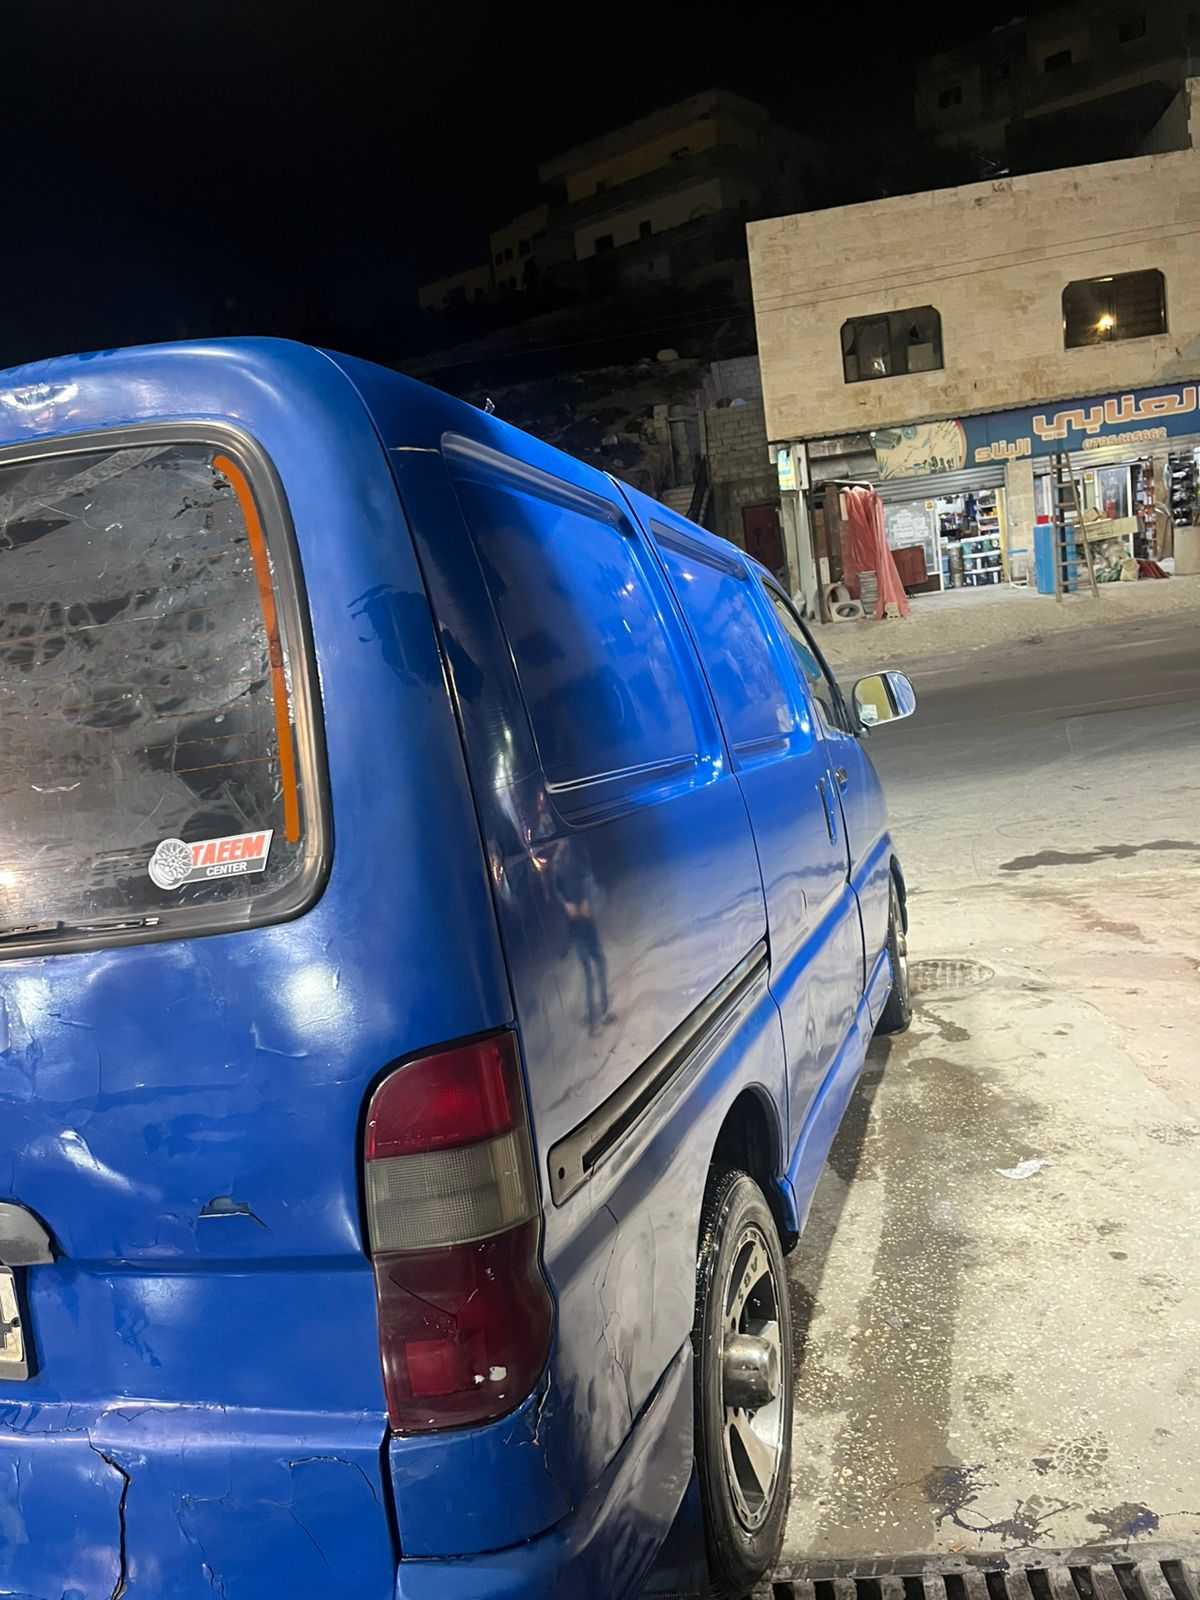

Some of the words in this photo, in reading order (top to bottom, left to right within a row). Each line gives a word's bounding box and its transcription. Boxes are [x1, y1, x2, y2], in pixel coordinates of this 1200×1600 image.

[1033, 386, 1200, 441] لعنابي
[191, 835, 265, 866] TAEEM
[206, 862, 248, 876] CENTER
